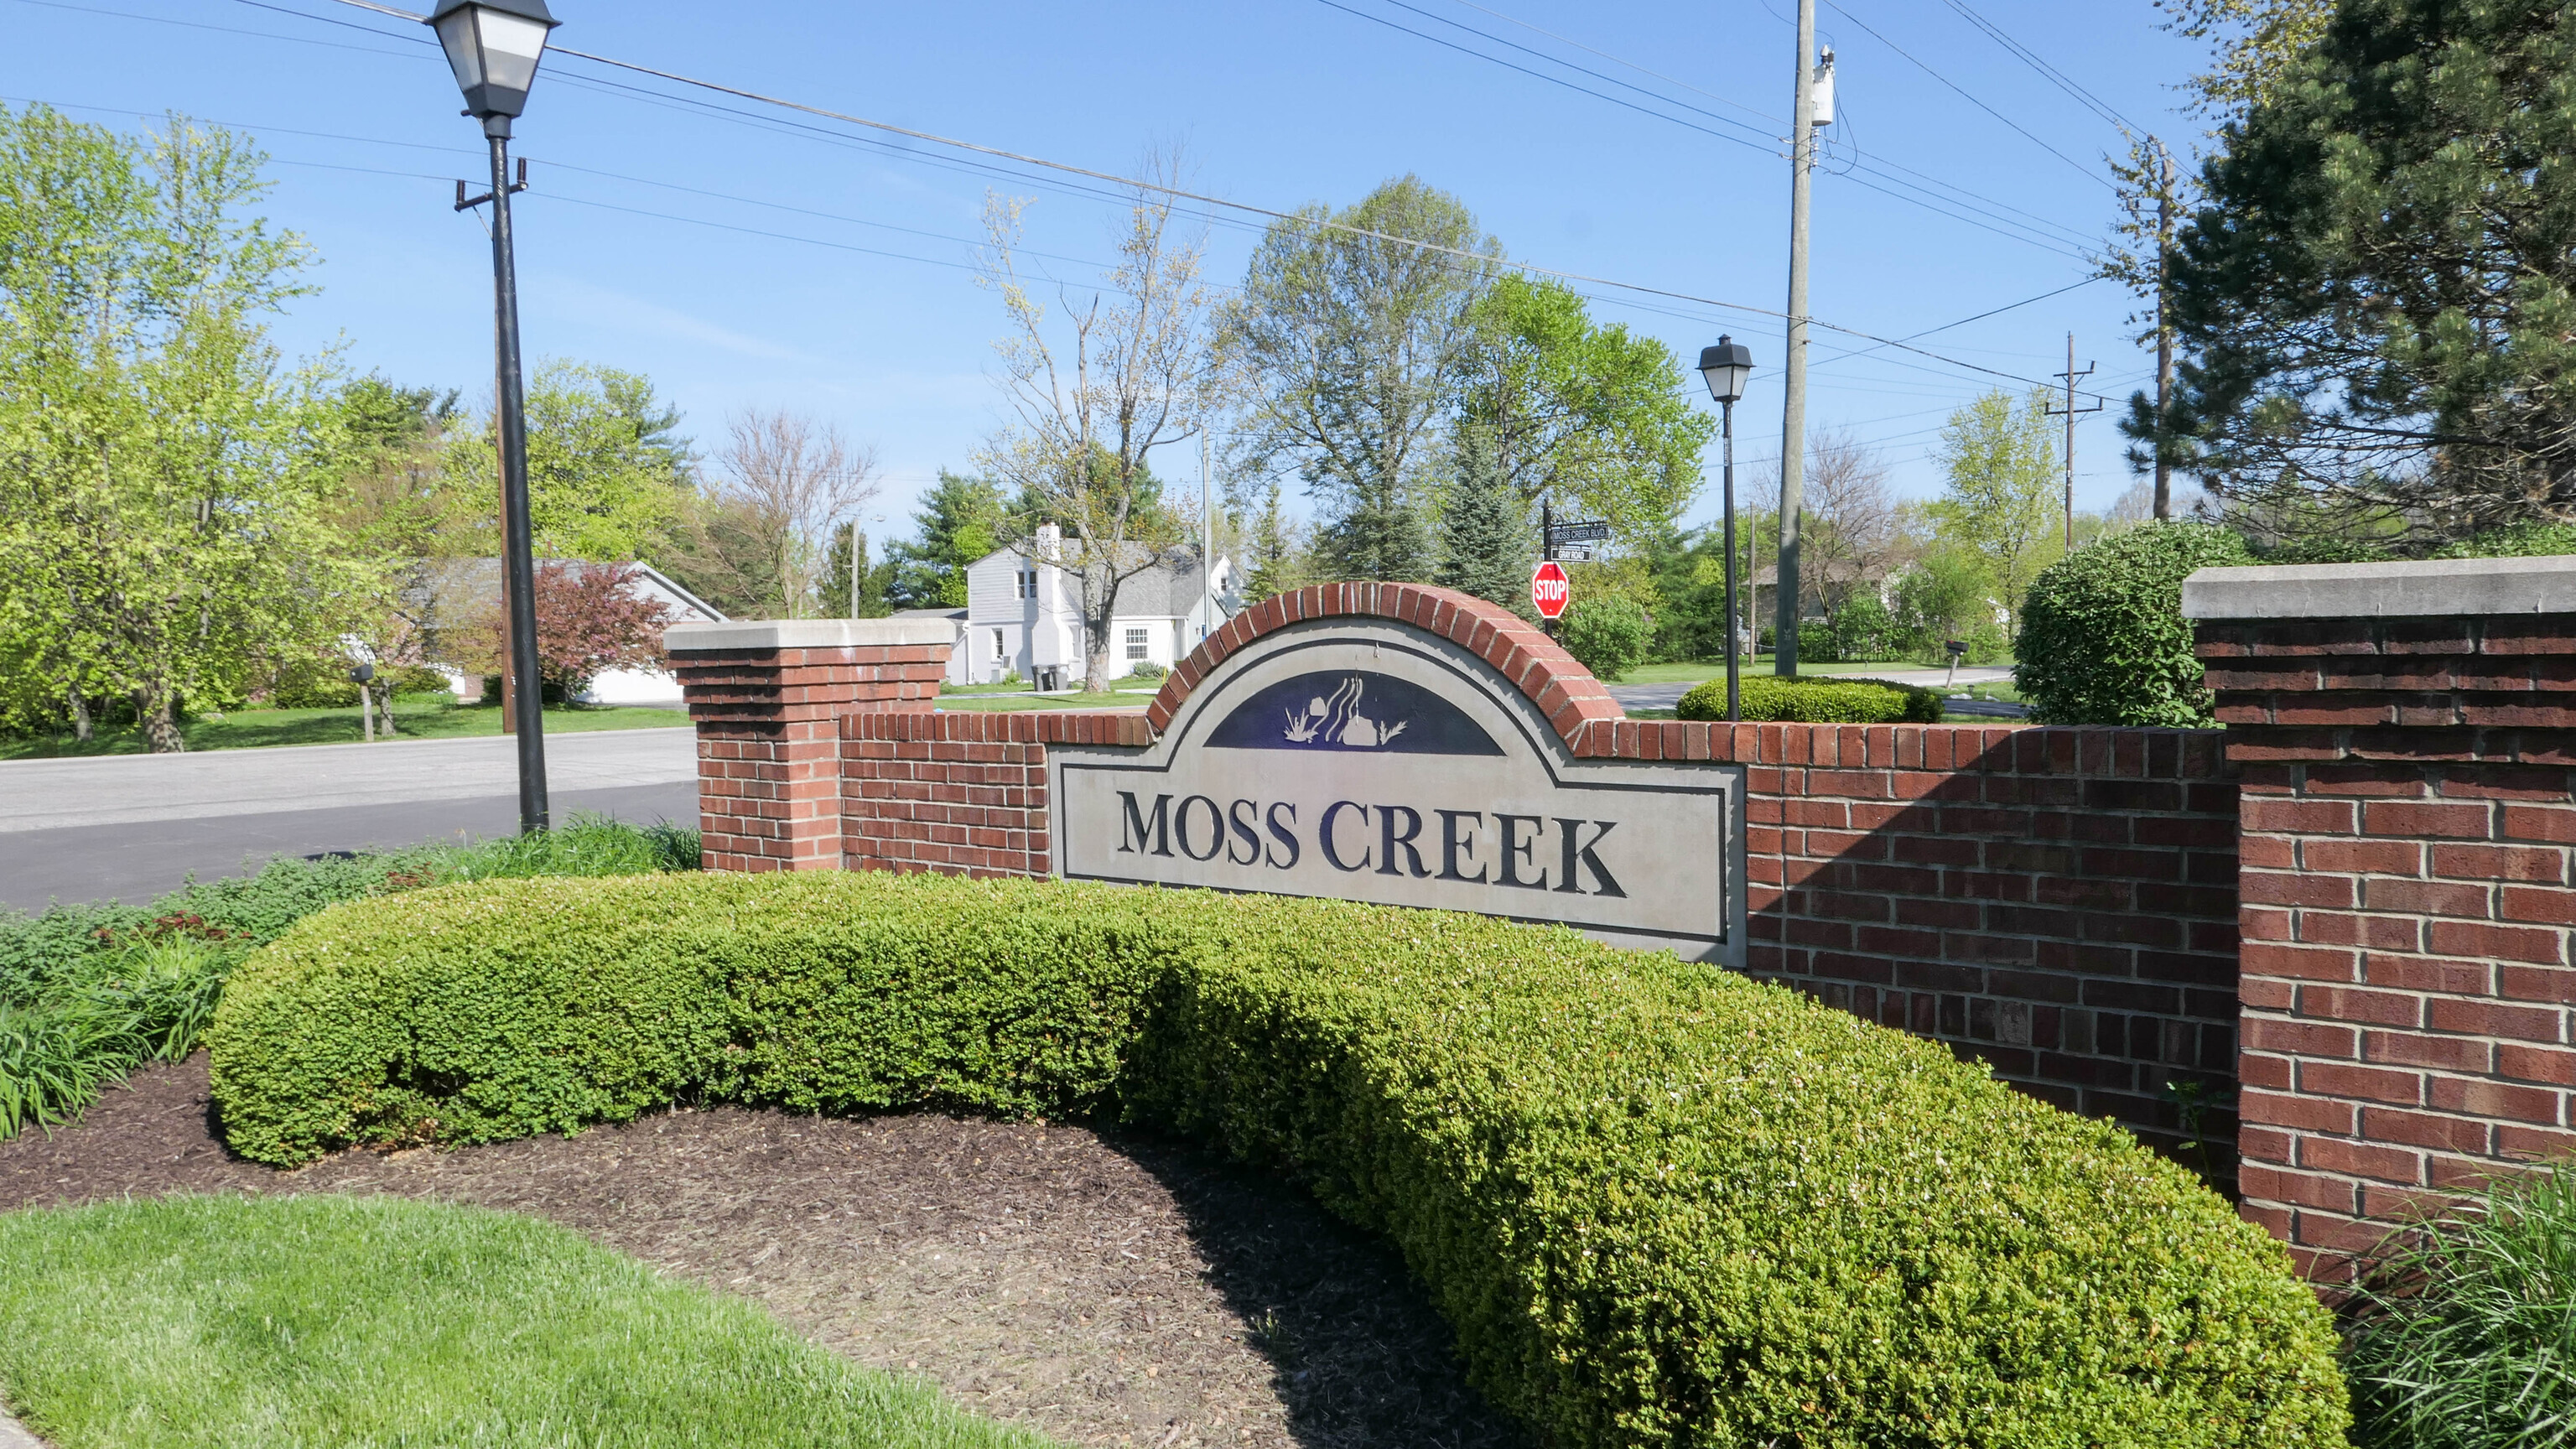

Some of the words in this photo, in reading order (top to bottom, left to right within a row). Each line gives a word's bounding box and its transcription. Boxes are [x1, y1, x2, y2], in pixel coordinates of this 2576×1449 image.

[1554, 531, 1571, 540] MOSS
[1571, 529, 1590, 538] CREEK
[1571, 550, 1585, 560] ROAD
[1535, 579, 1566, 600] STOP
[1116, 790, 1300, 870] MOSS
[1318, 800, 1628, 899] CREEK
